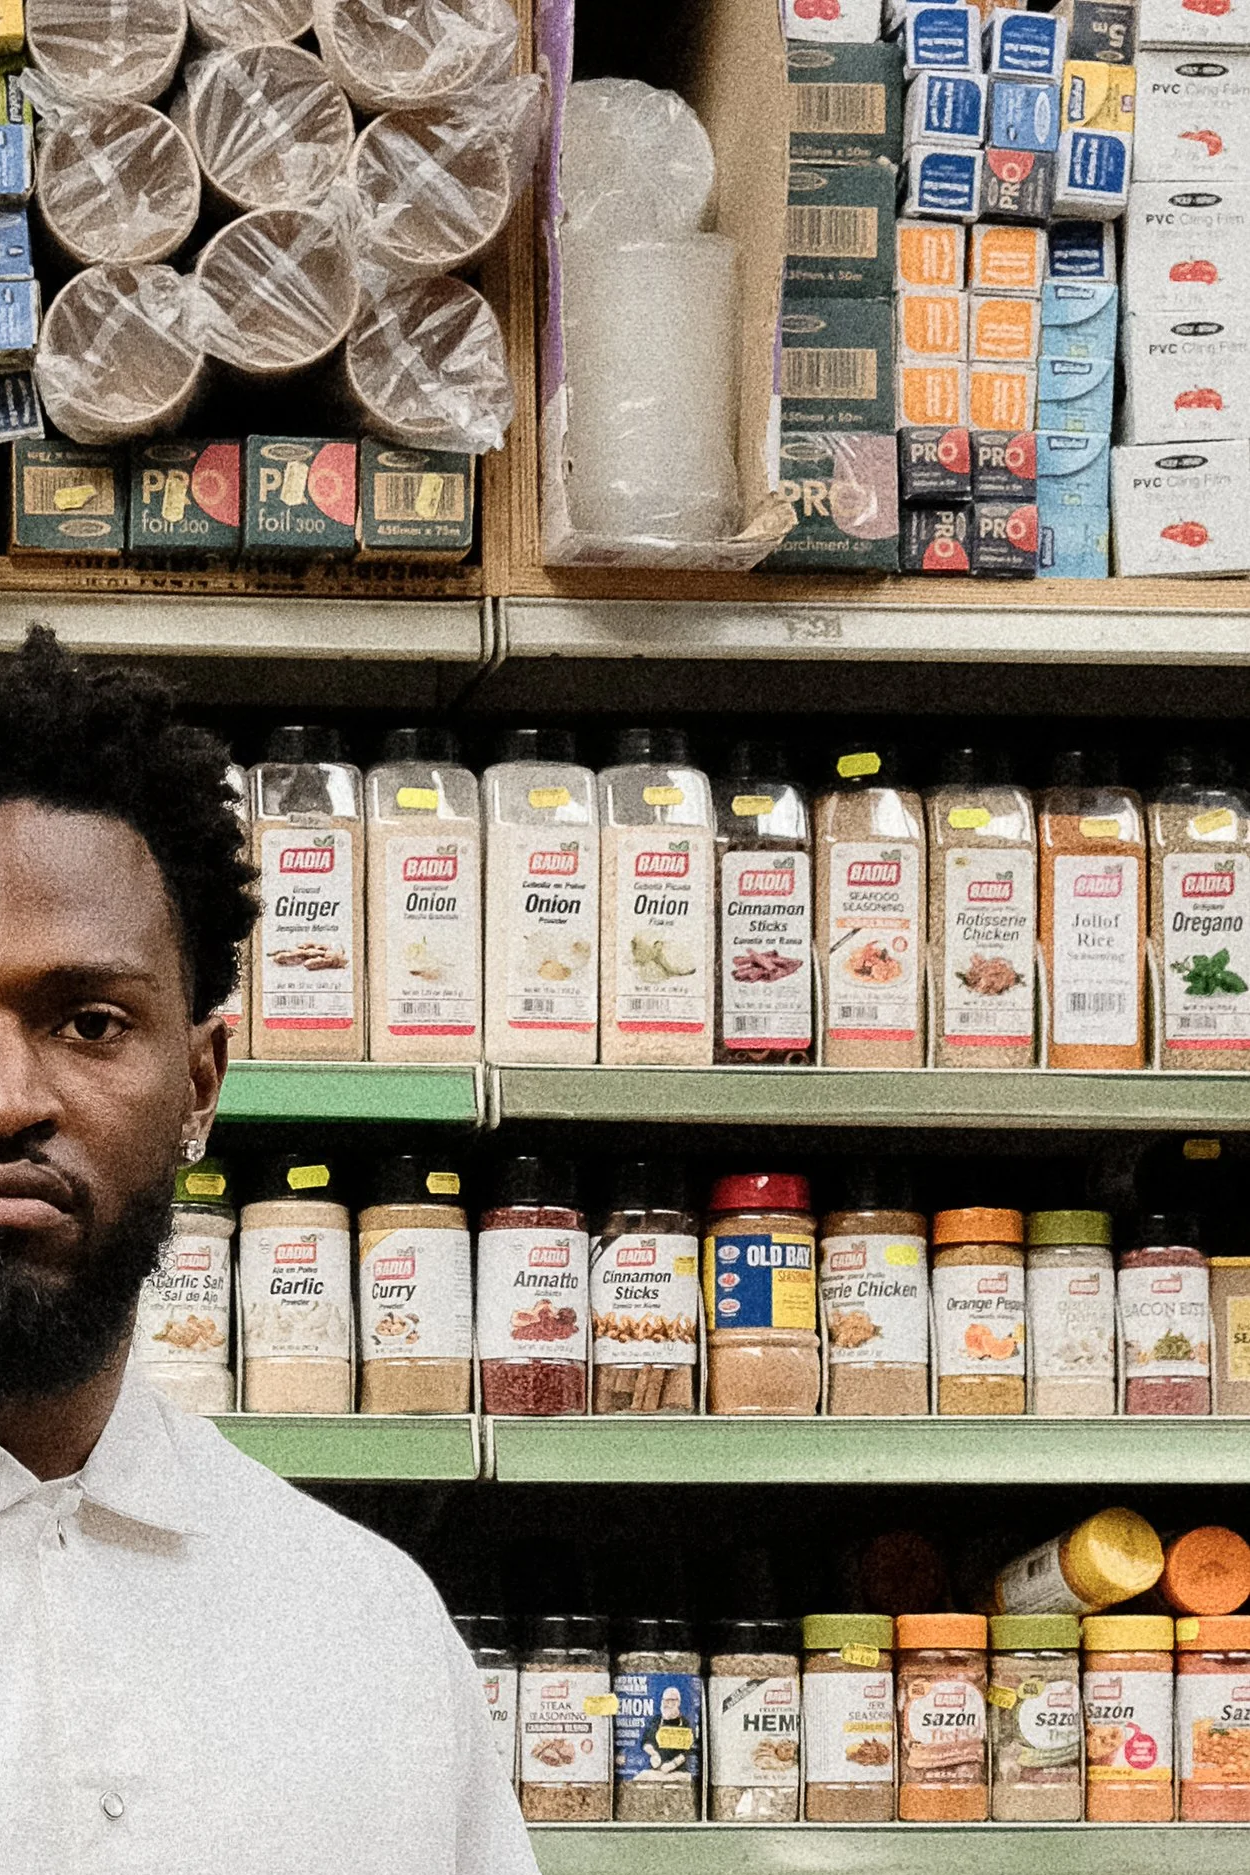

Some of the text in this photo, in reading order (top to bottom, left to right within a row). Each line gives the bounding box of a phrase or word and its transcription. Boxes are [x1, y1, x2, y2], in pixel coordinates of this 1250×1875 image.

[1152, 84, 1180, 95] PVC
[1000, 161, 1022, 210] PRO
[911, 441, 957, 463] PRO
[1133, 477, 1161, 489] PVC
[778, 479, 866, 516] PRO
[141, 510, 209, 534] foil 300
[258, 508, 326, 534] foil 300
[979, 517, 1026, 540] PRO
[934, 511, 956, 558] PRO
[282, 850, 332, 871] BADIA
[405, 859, 455, 879] BADIA
[637, 854, 687, 875] BADIA
[406, 892, 457, 912] Onion
[525, 893, 582, 914] Onion
[634, 894, 689, 917] Onion
[849, 892, 900, 902] SEAFOOD
[275, 896, 340, 921] Ginger
[727, 901, 805, 917] Cinnamon
[842, 902, 905, 913] SEASONING
[749, 920, 788, 933] Sticks
[956, 913, 1026, 928] Rotisserie
[1071, 913, 1121, 928] Jollof
[1172, 911, 1244, 936] Oregano
[962, 927, 1020, 942] Chicken
[1077, 932, 1115, 948] Rice
[747, 1245, 812, 1267] OLD BAY
[513, 1271, 579, 1289] Annatto
[603, 1270, 671, 1283] Cinnamon
[270, 1278, 324, 1295] Garlic
[372, 1283, 417, 1301] Curry
[615, 1286, 659, 1300] Sticks
[857, 1281, 918, 1298] Chicken
[947, 1297, 992, 1313] Orange
[540, 1701, 572, 1711] STEAK
[1086, 1703, 1134, 1719] Sazón
[529, 1712, 587, 1722] SEASONING
[922, 1709, 976, 1726] sazón
